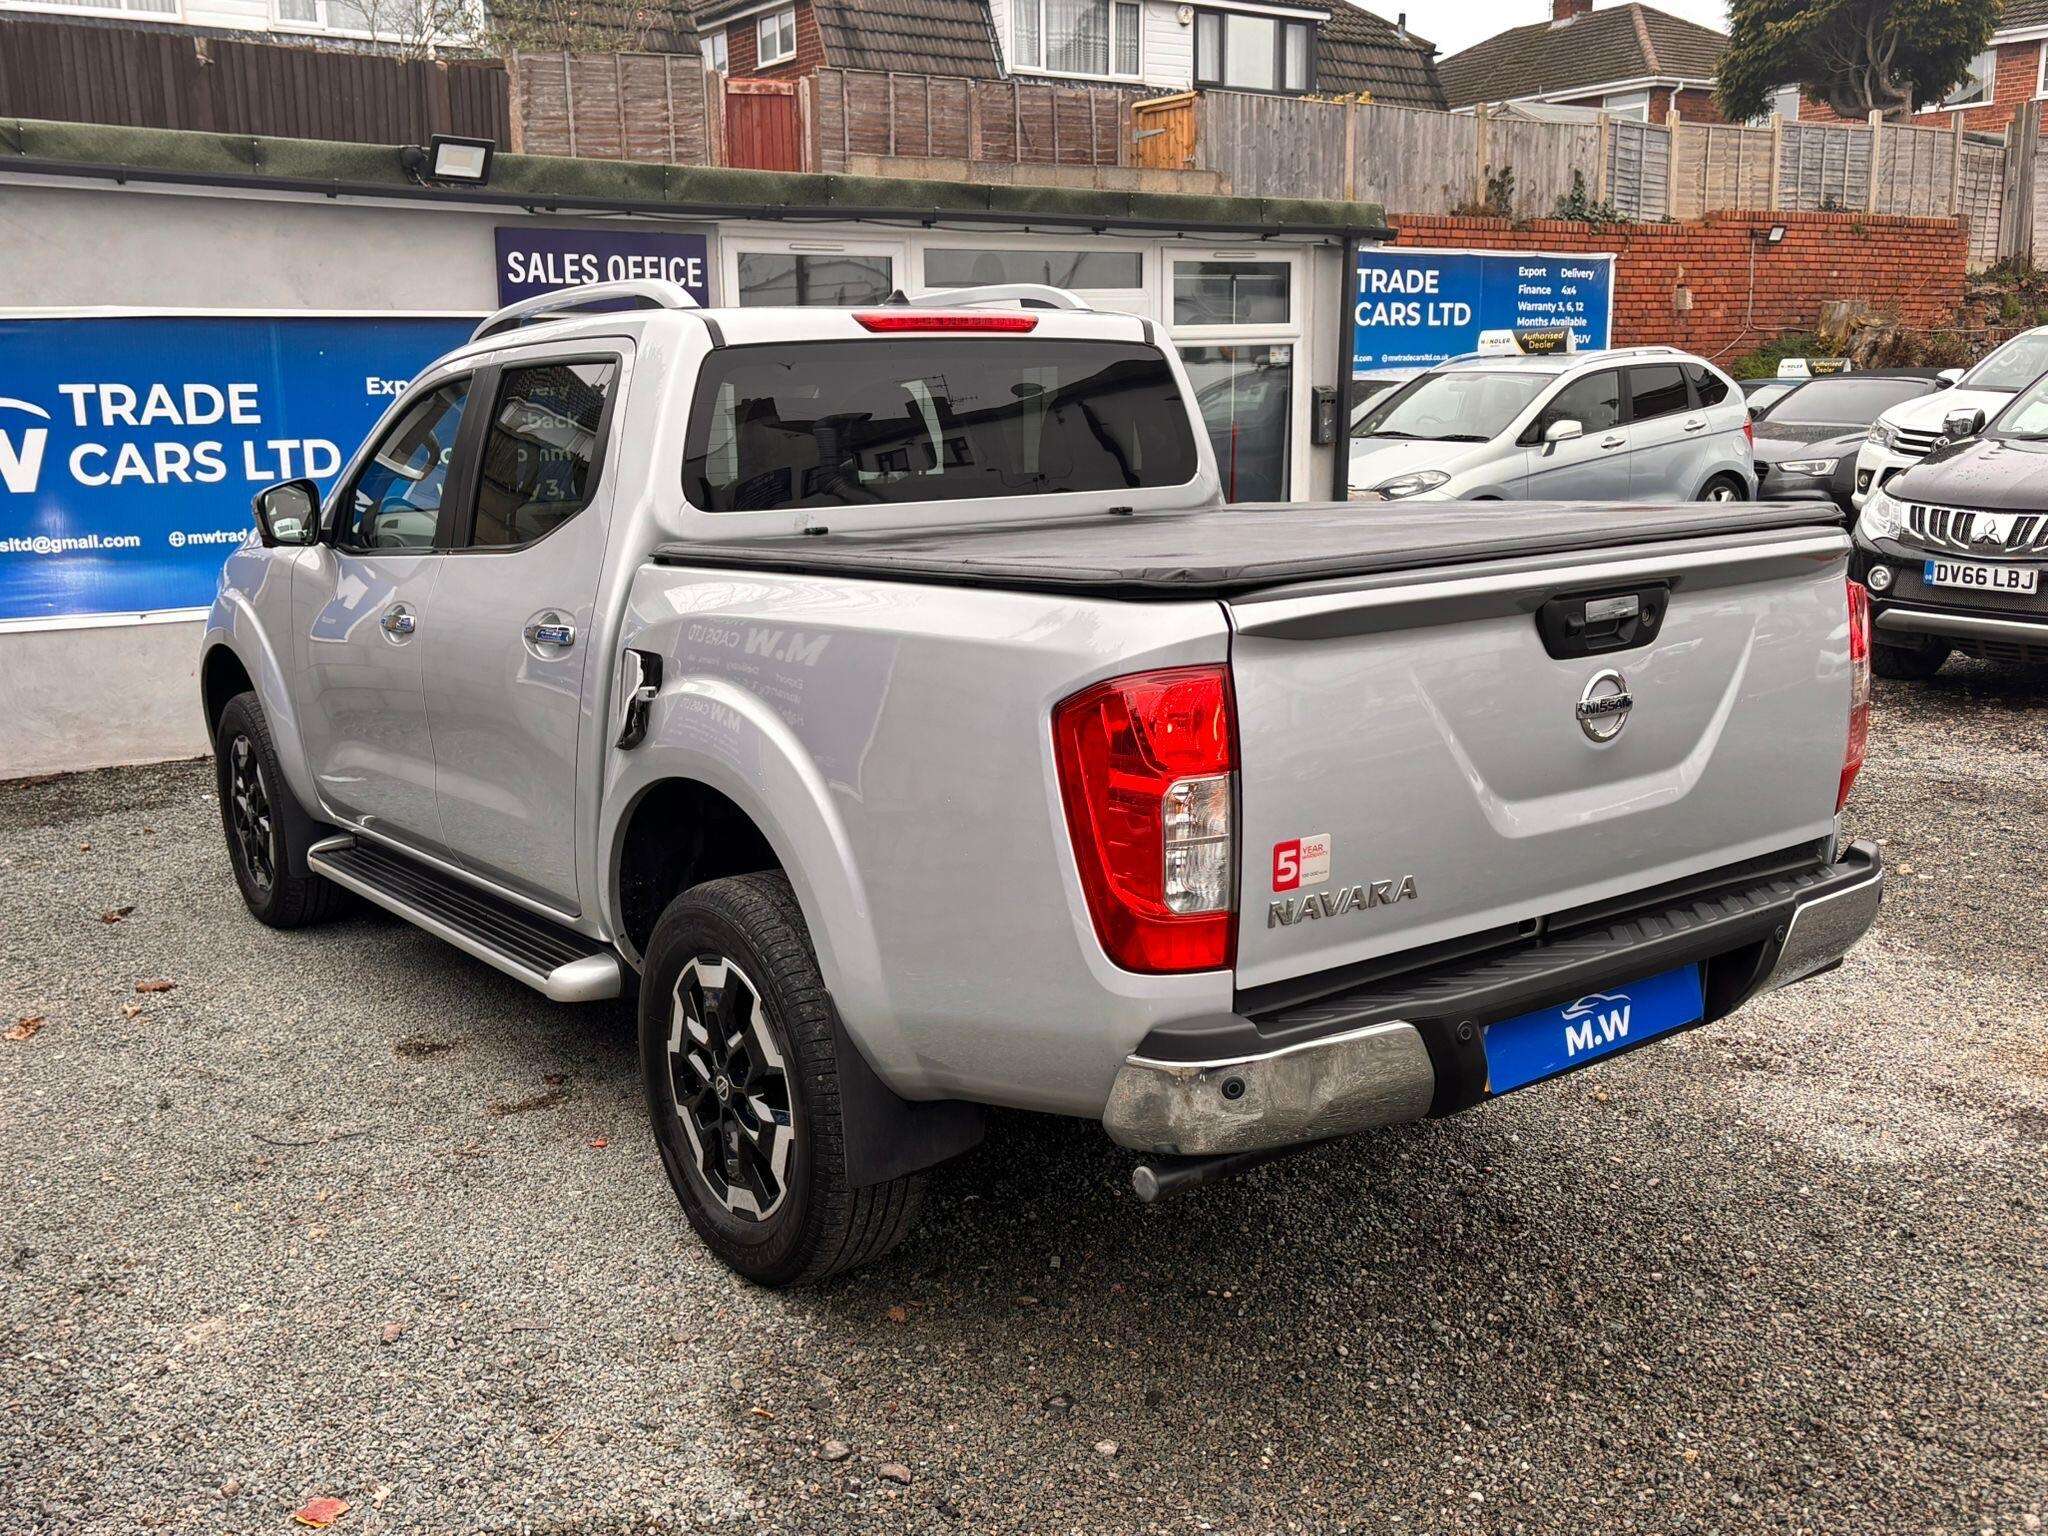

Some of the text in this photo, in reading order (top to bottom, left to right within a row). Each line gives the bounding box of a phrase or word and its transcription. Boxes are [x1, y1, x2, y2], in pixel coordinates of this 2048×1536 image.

[507, 251, 703, 288] SALES OFFICE
[1357, 268, 1440, 294] TRADE
[1518, 266, 1594, 280] Export Delivery
[1518, 284, 1577, 295] Finance 4x4
[1354, 302, 1472, 327] CARS LTD
[1517, 301, 1584, 313] Warranty 3, 6, 12
[1517, 316, 1587, 326] Months Available
[1522, 331, 1565, 341] Authorised
[1528, 340, 1555, 349] Dealer
[58, 383, 262, 427] TRADE
[69, 439, 342, 486] CARS LTD
[1936, 564, 2034, 590] DV66 LBJ
[1585, 697, 1632, 715] NISSAN
[1303, 843, 1324, 854] YEAR
[1277, 848, 1298, 883] 5
[1268, 874, 1418, 929] NAVARA
[1565, 1004, 1631, 1057] M.W
